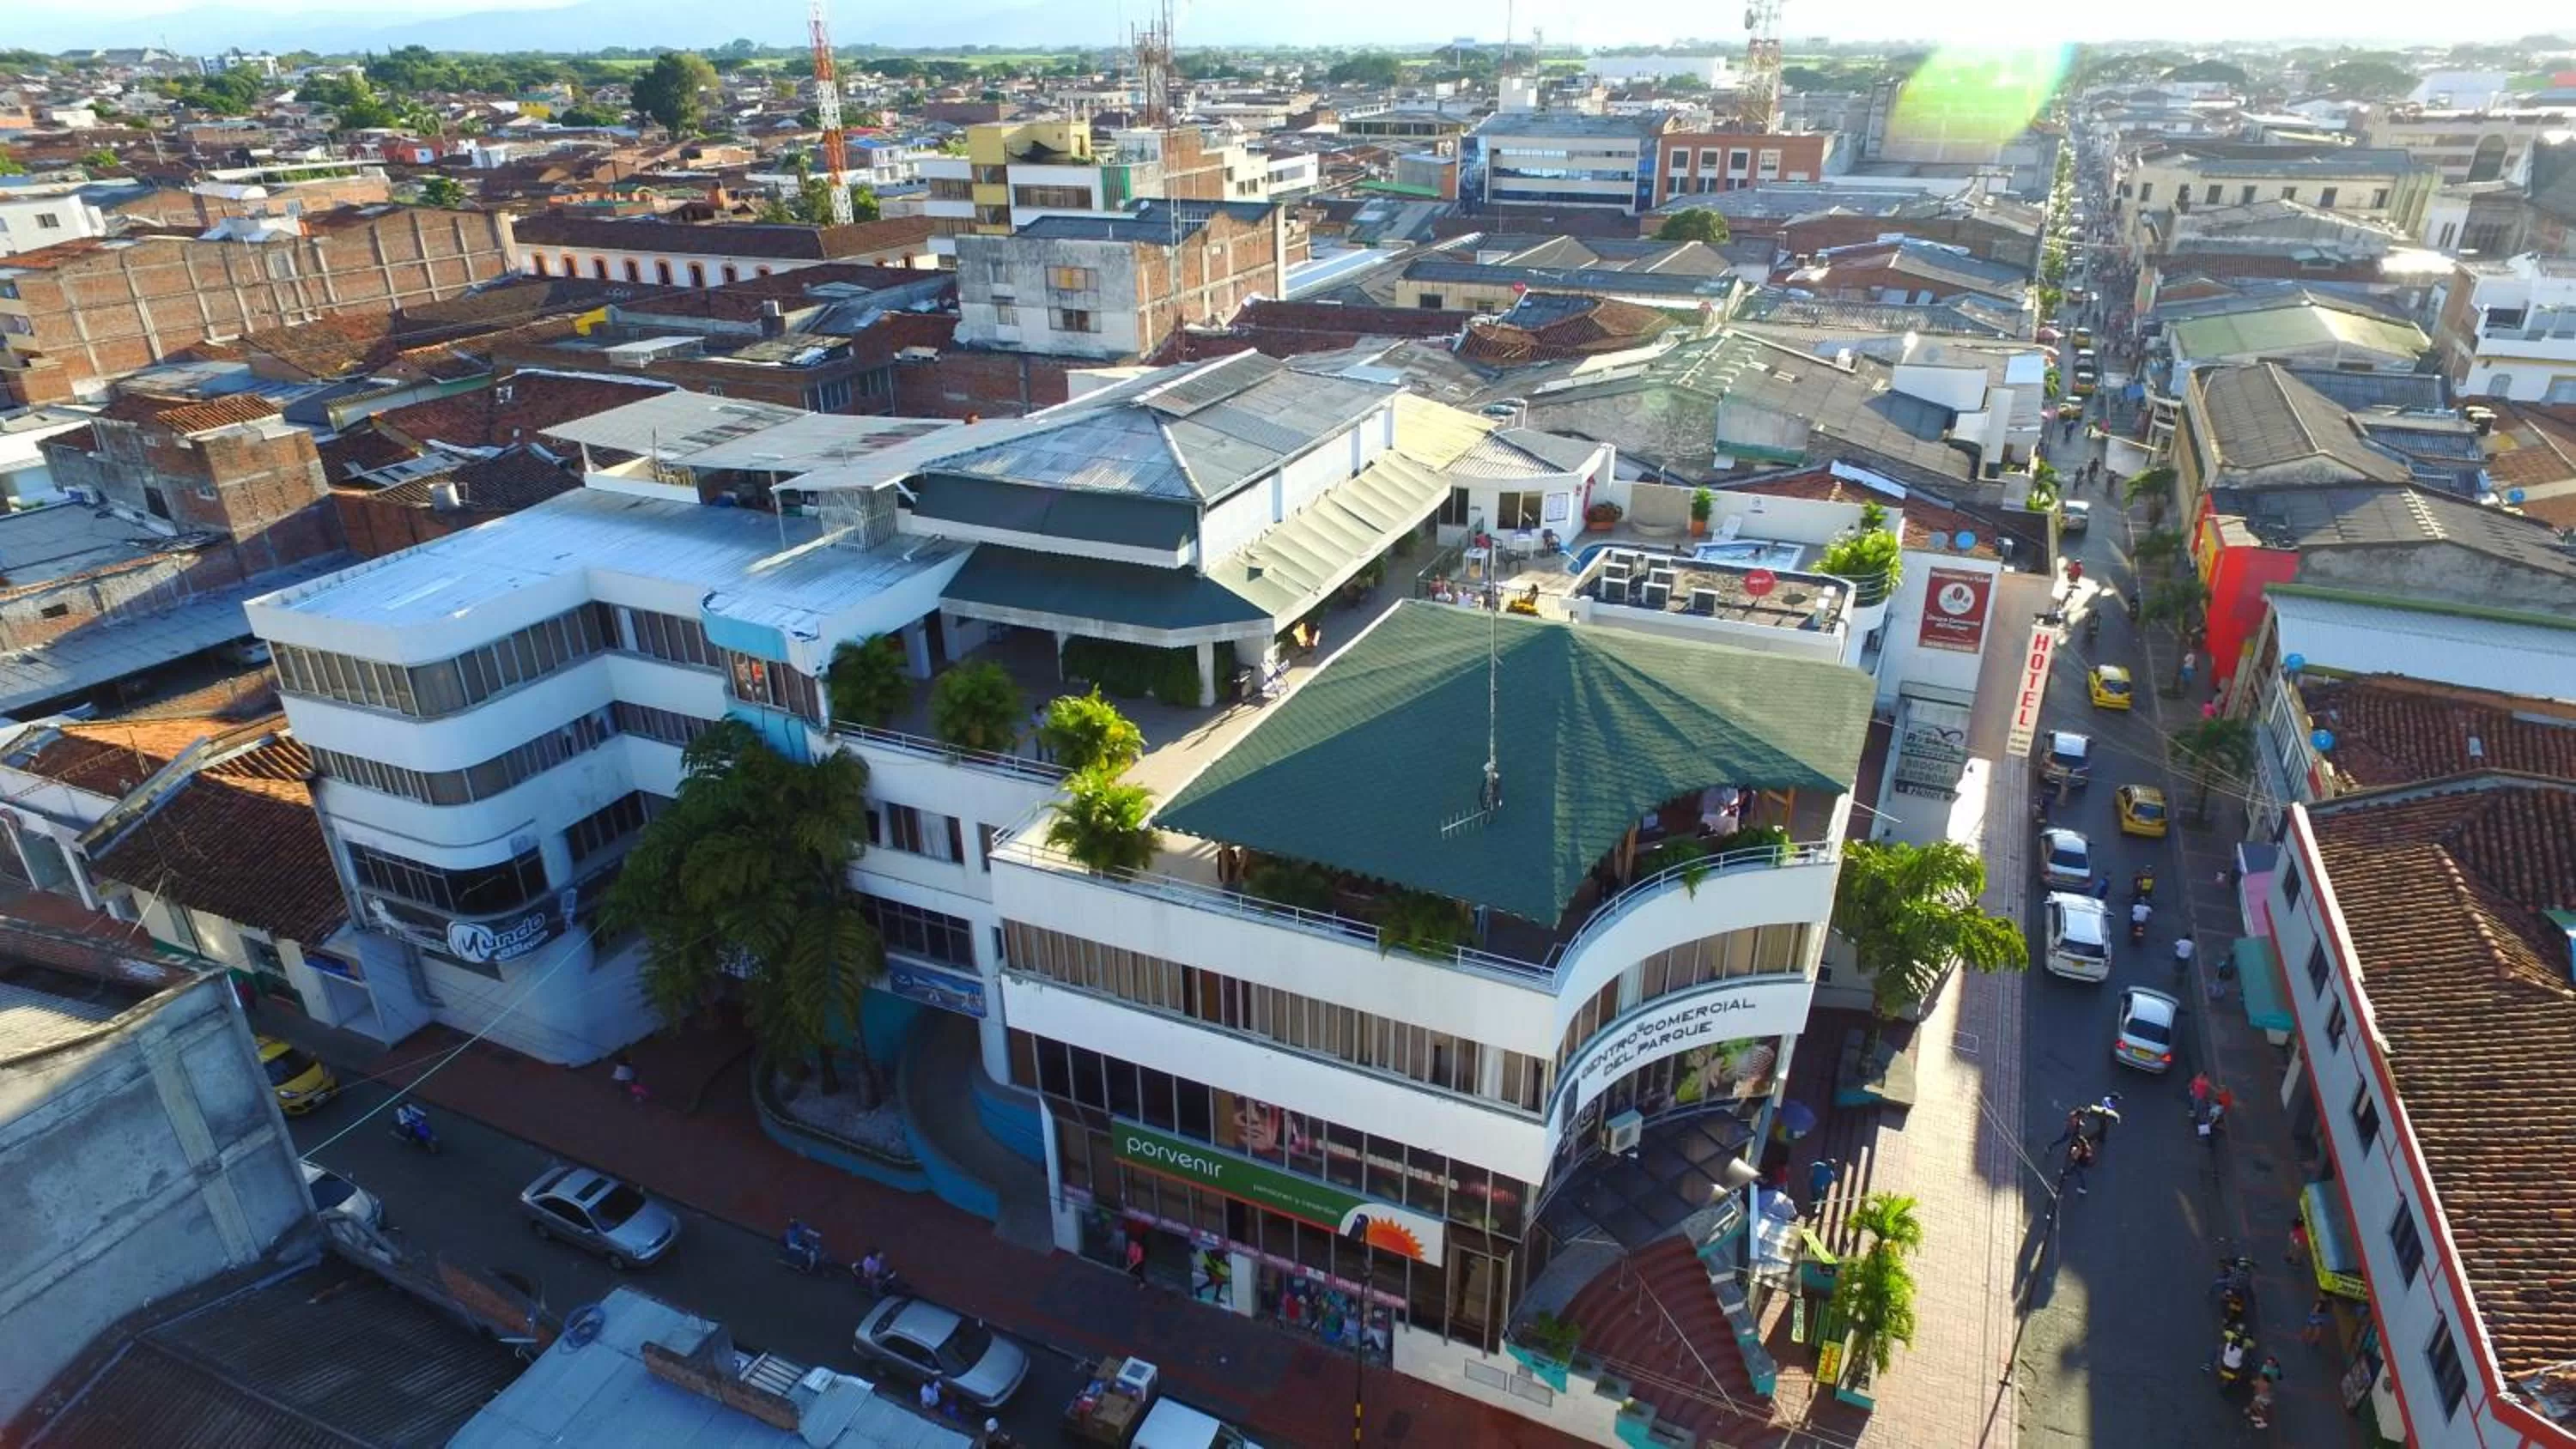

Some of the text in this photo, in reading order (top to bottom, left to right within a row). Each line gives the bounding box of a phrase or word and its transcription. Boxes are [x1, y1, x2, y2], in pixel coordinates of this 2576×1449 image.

[2019, 634, 2050, 726] HOTEL
[1581, 998, 1756, 1080] CENTRO COMERCIAL
[1603, 1021, 1713, 1077] DEL PARQUE
[1127, 1136, 1223, 1179] porvenir
